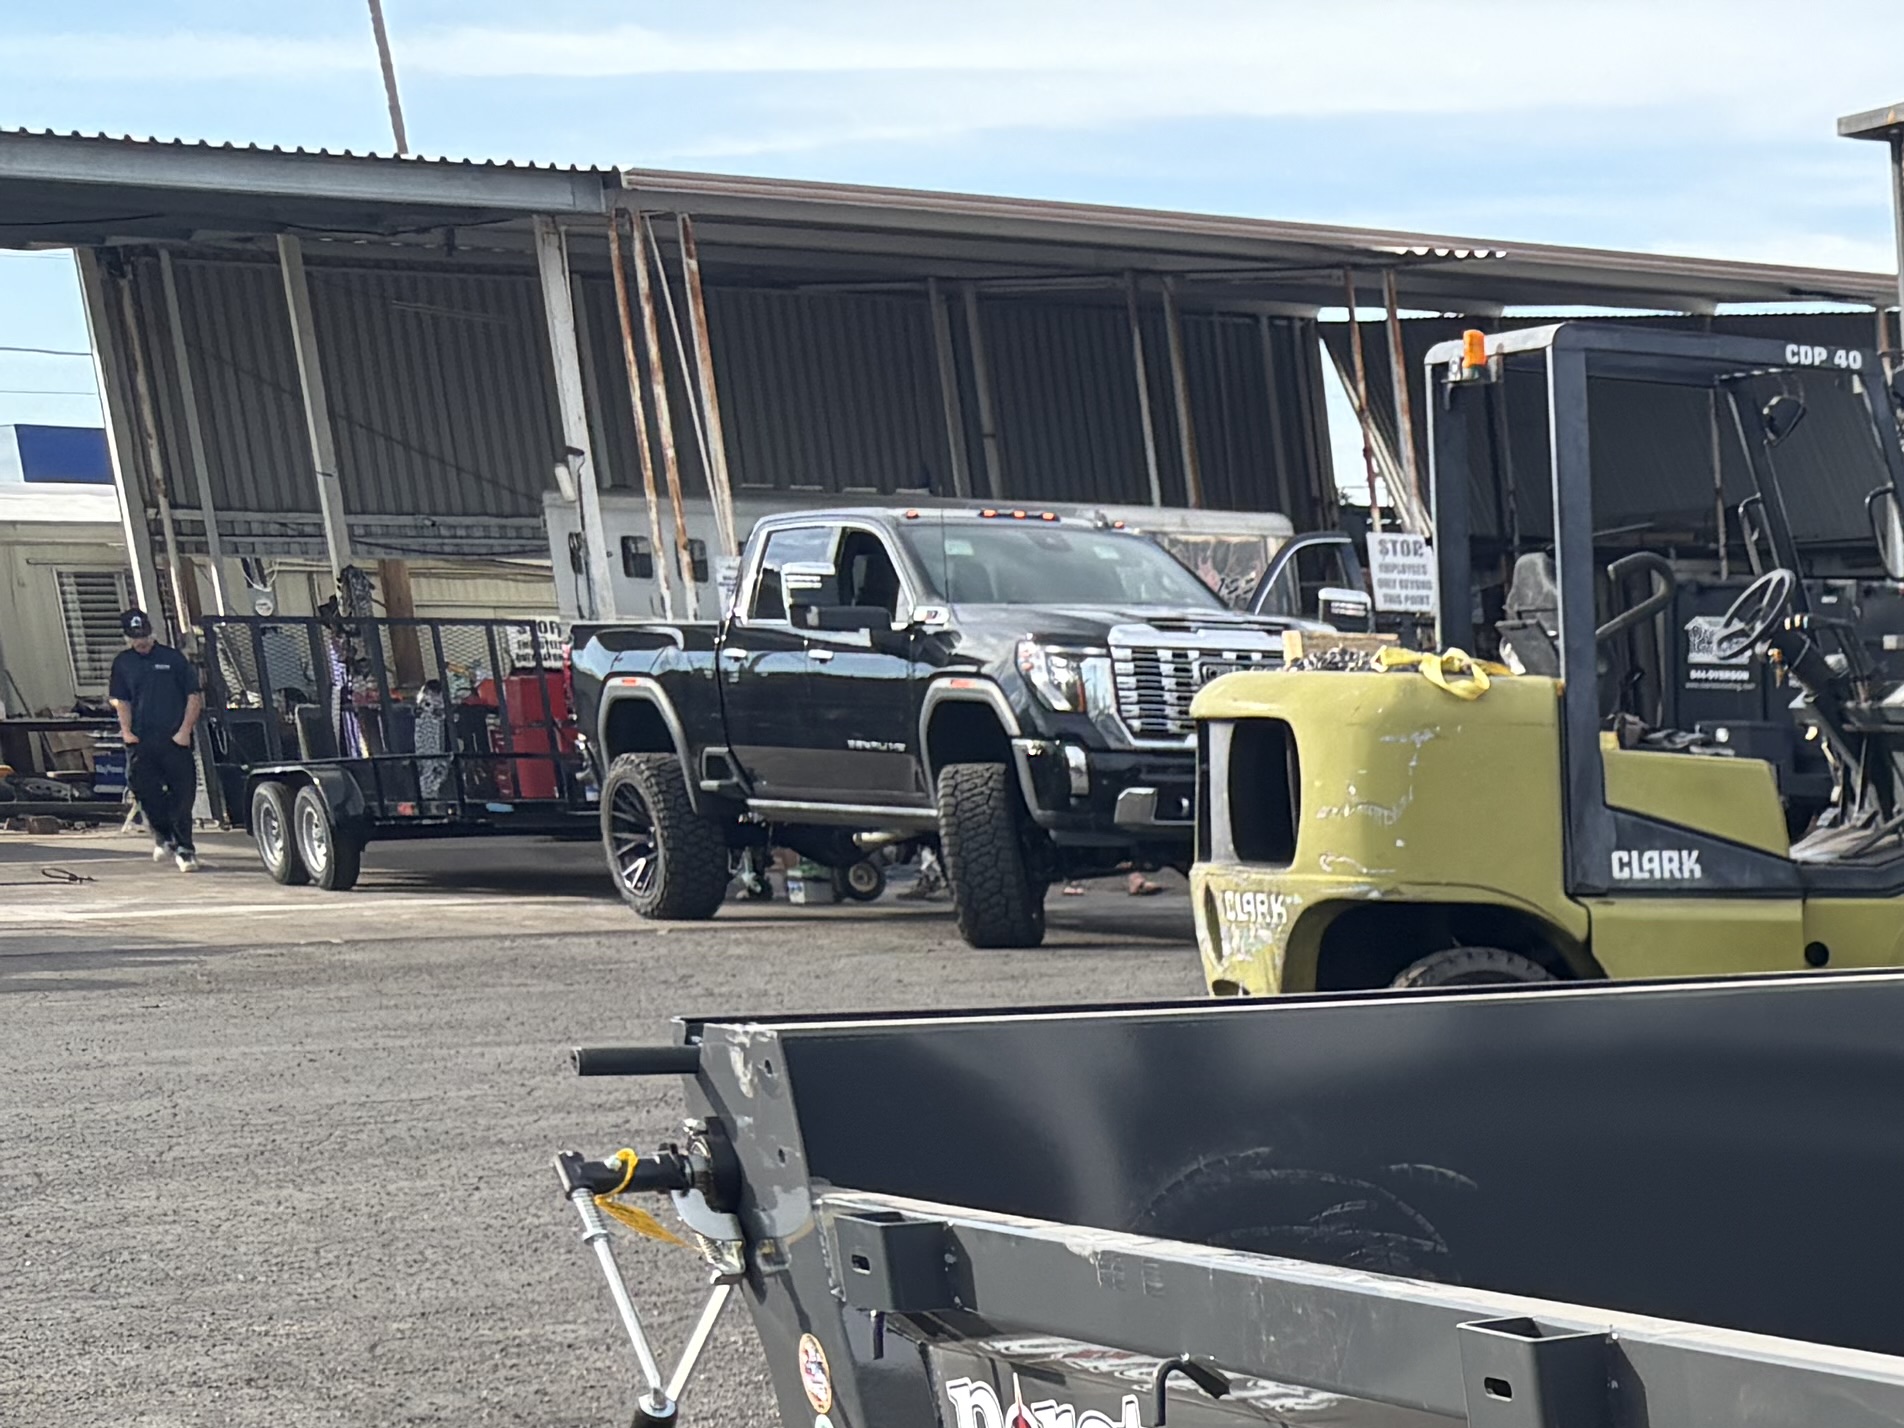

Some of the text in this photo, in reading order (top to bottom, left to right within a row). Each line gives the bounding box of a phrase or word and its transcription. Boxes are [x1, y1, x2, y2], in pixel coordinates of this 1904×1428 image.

[1785, 344, 1862, 369] CDP 40
[1378, 539, 1424, 557] STOP
[1611, 850, 1702, 879] CLARK
[1223, 891, 1287, 924] CLARK
